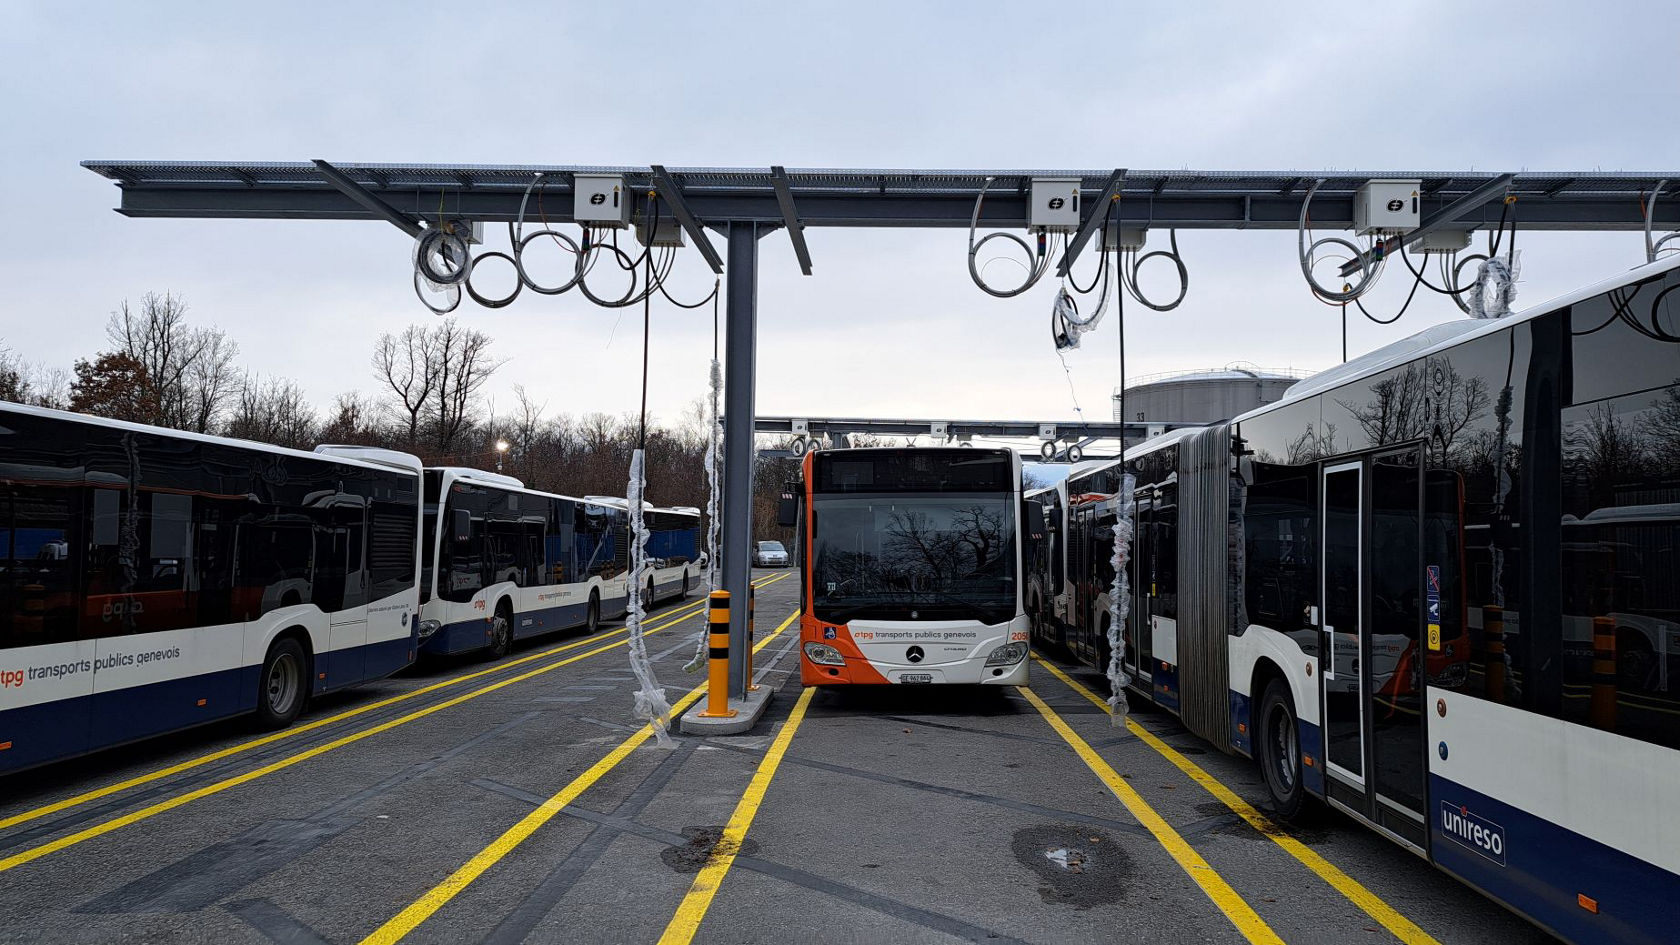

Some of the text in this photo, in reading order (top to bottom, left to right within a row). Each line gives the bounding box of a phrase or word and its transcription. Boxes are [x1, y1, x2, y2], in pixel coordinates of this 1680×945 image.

[1137, 412, 1145, 422] 33
[860, 630, 977, 640] tpg transports publics genevois
[0, 645, 181, 688] tpg transports publics genevois
[1443, 806, 1502, 855] unireso
